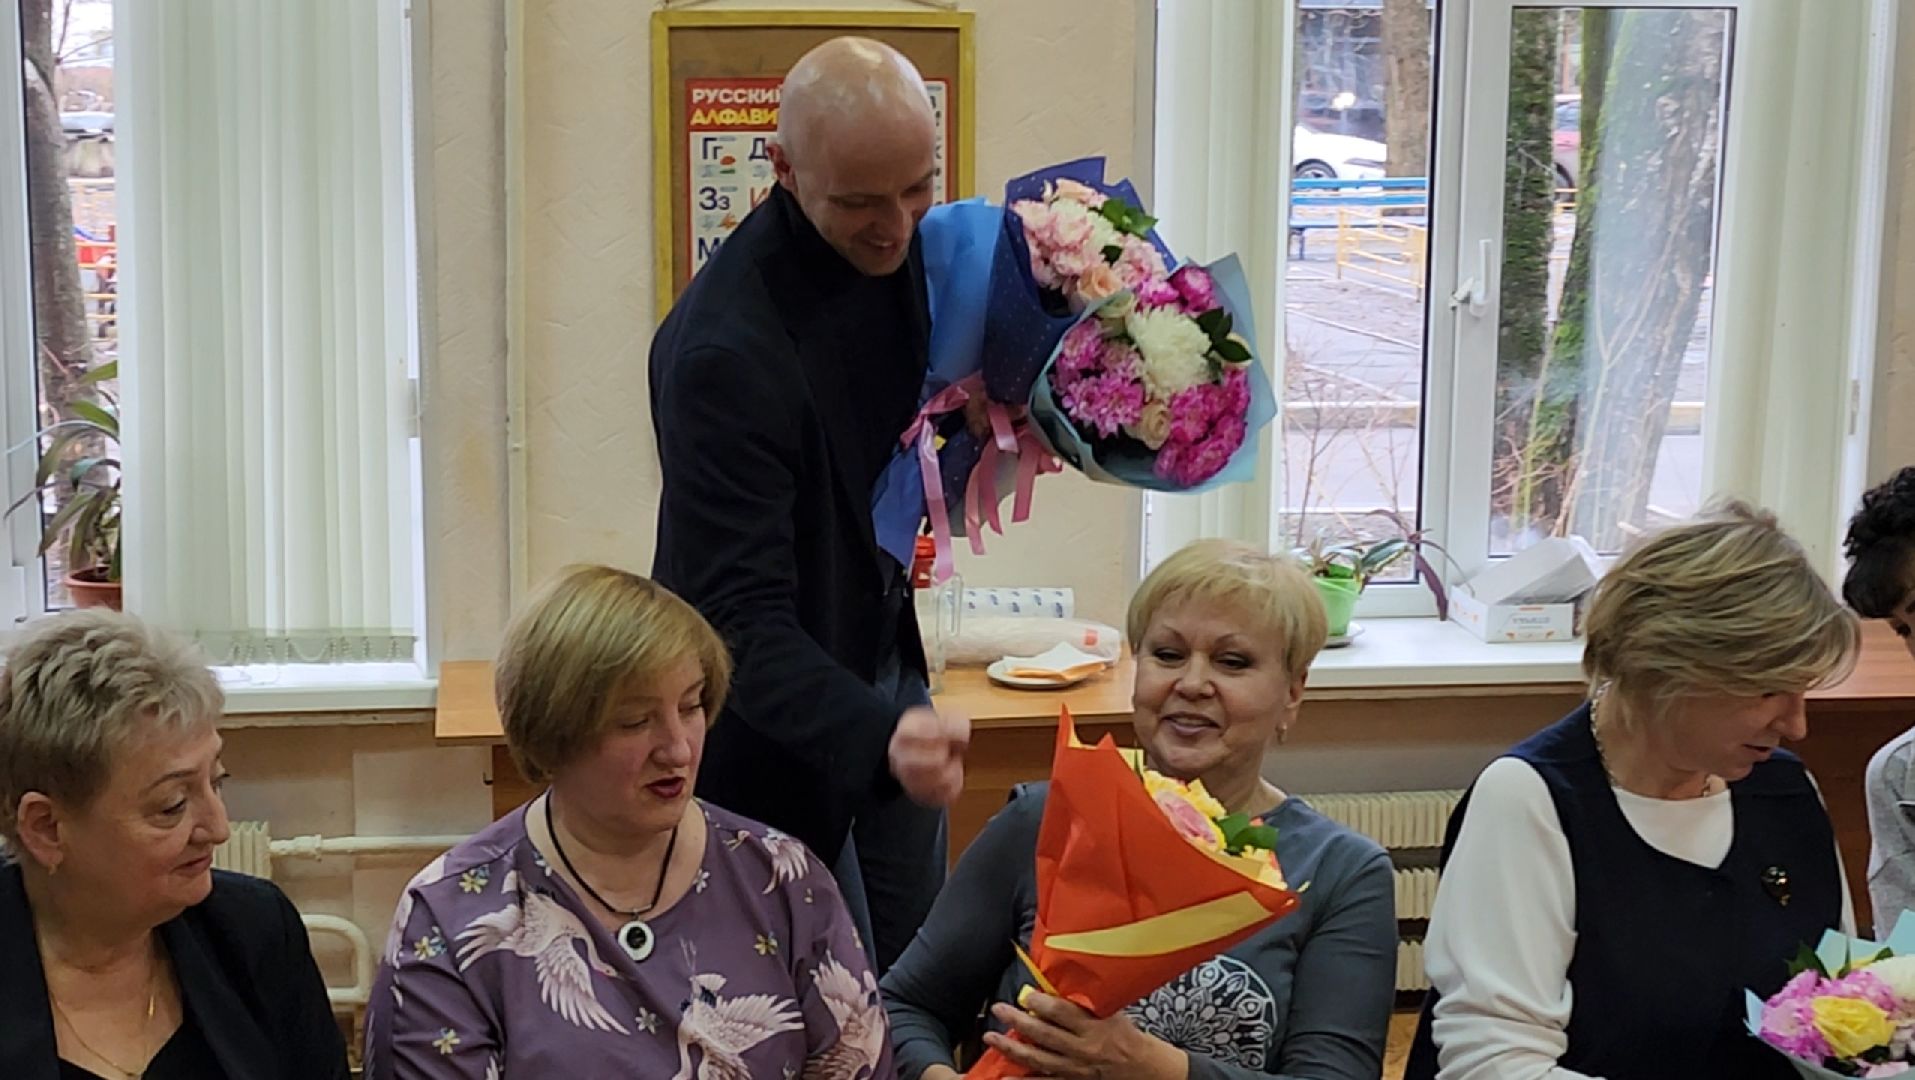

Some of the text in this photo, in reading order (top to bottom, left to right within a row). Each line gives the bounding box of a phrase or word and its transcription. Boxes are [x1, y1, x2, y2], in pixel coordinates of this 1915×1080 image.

[690, 107, 780, 126] АЛФАВИ
[702, 137, 723, 160] Гг
[699, 186, 730, 210] Зз
